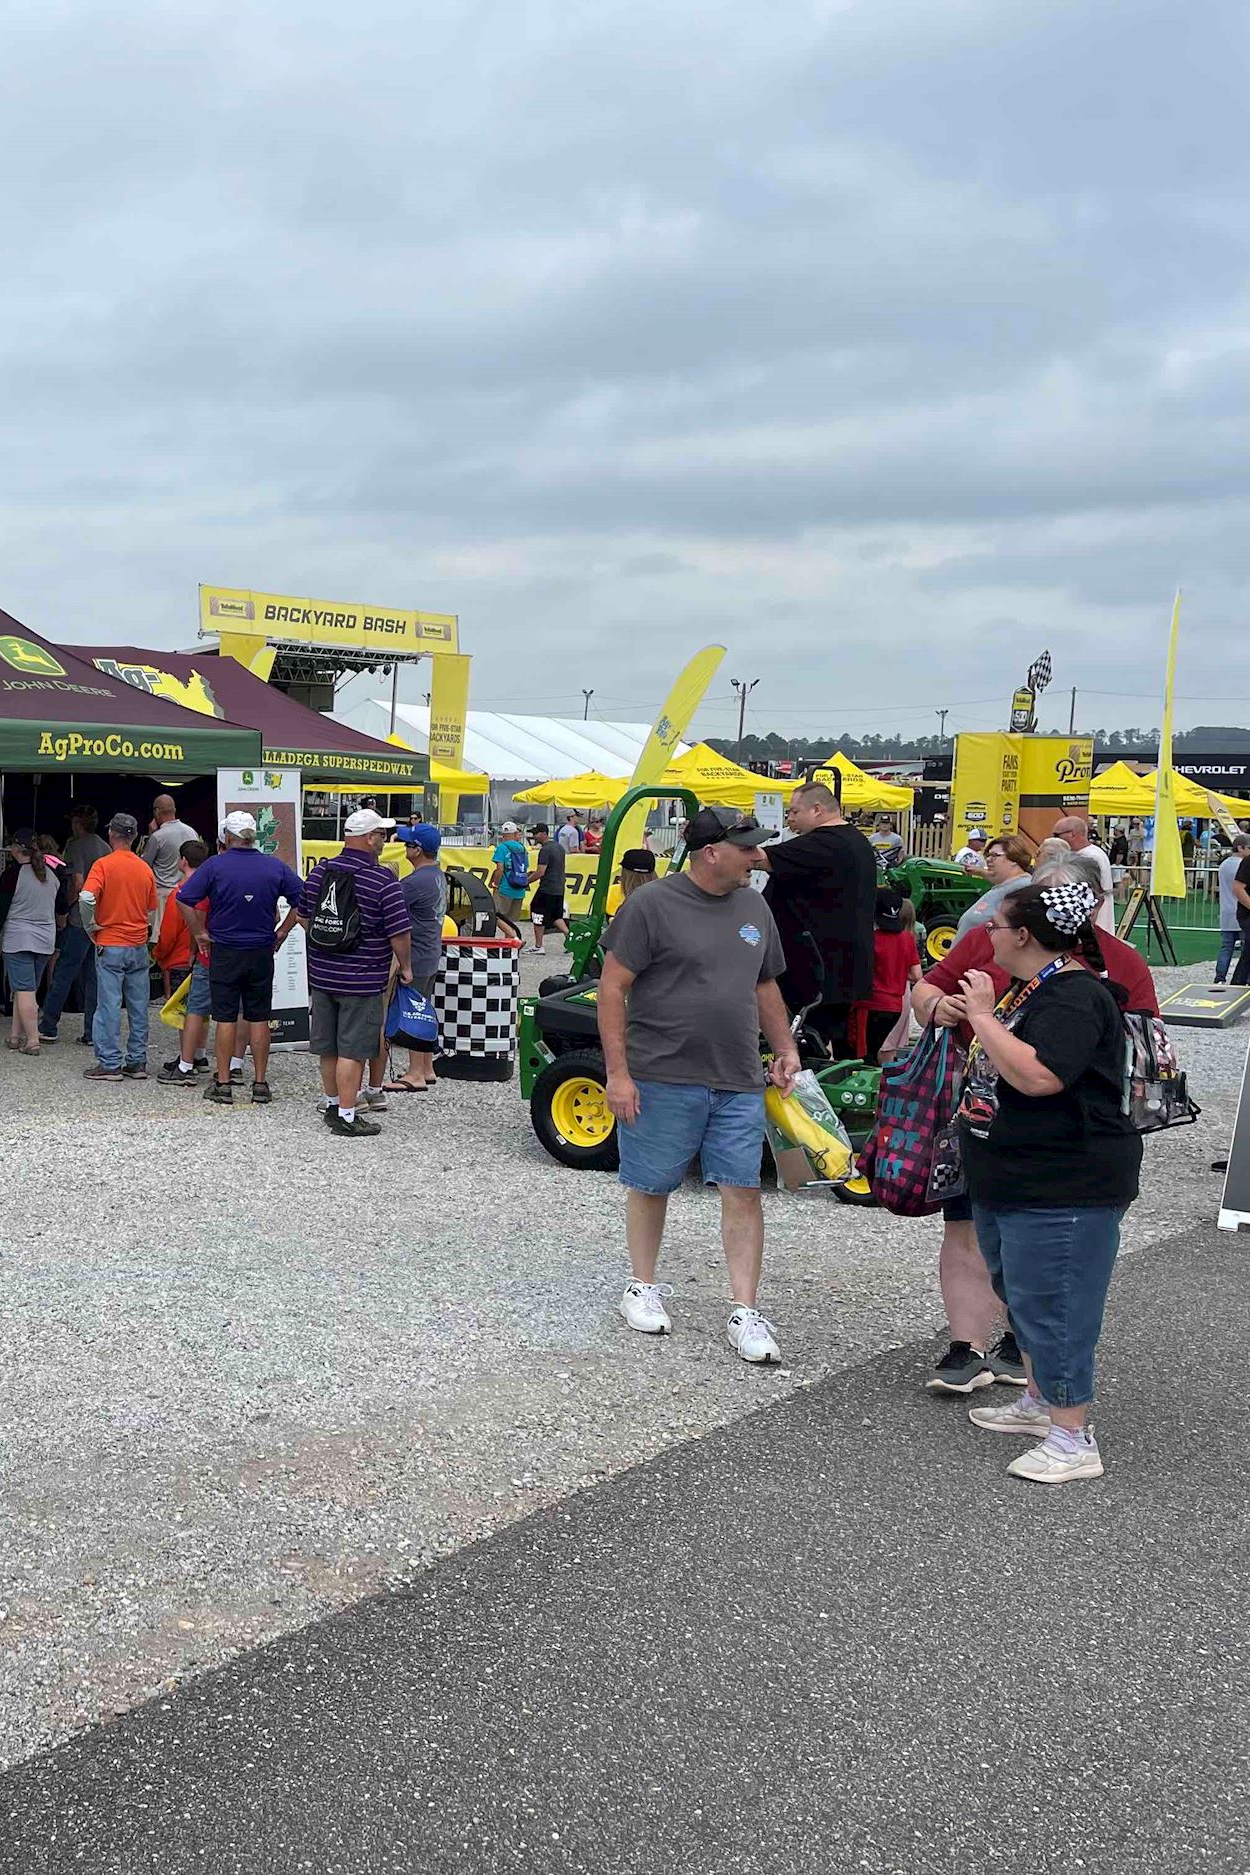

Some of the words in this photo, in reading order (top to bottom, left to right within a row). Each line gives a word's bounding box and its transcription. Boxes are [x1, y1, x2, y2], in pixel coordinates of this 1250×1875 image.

[265, 605, 356, 629] BACKYARD
[363, 616, 406, 634] BASH
[2, 679, 52, 691] JOHN
[55, 680, 117, 698] DEERE
[38, 732, 184, 760] AgProCo.com
[263, 751, 320, 767] LLADEGA
[322, 756, 413, 776] SUPERSPEEDWAY
[1003, 754, 1018, 770] FANS
[1173, 765, 1247, 774] HEVROLET
[761, 1053, 775, 1062] OHN
